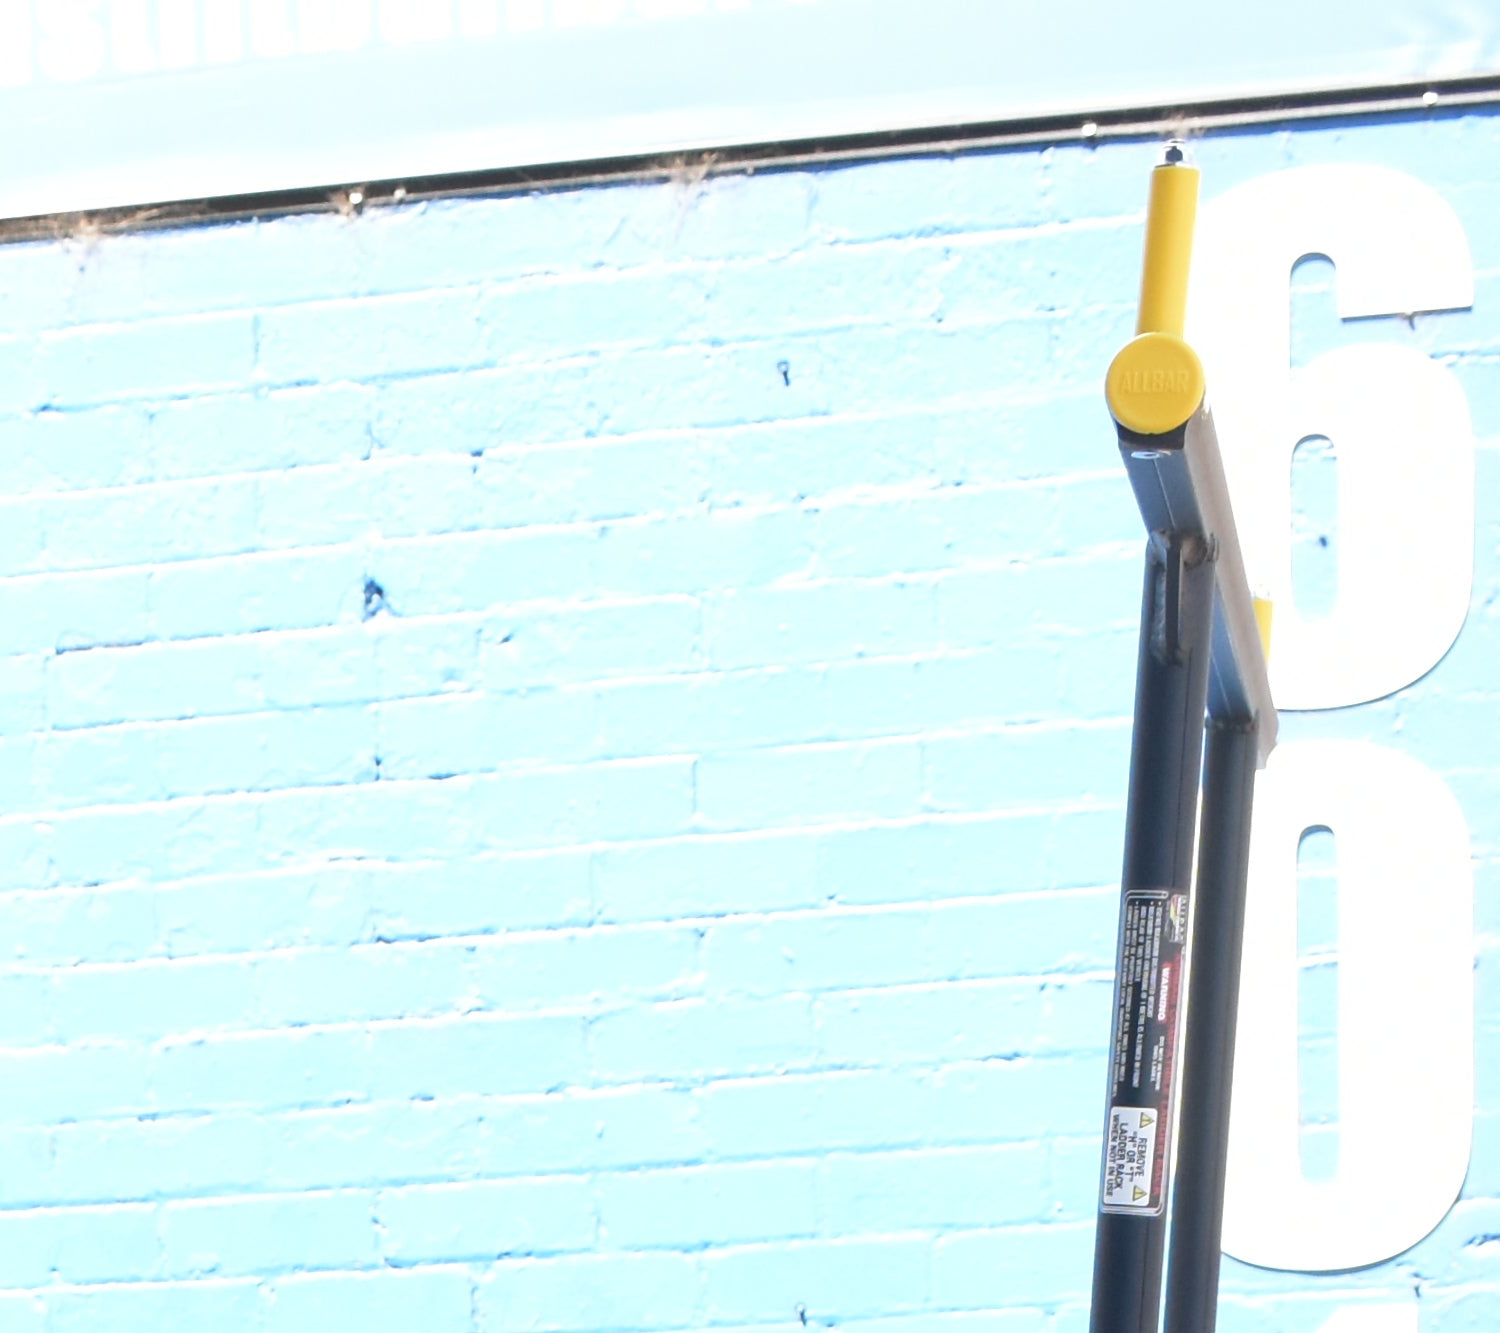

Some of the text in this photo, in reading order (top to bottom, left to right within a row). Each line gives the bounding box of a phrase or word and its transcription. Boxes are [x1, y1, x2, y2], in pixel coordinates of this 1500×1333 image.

[1109, 1113, 1120, 1143] WHEN
[1108, 1145, 1117, 1164] NOT
[1114, 1122, 1128, 1189] LADDER RACK
[1135, 1138, 1147, 1177] REMOVE
[1106, 1179, 1114, 1197] USE
